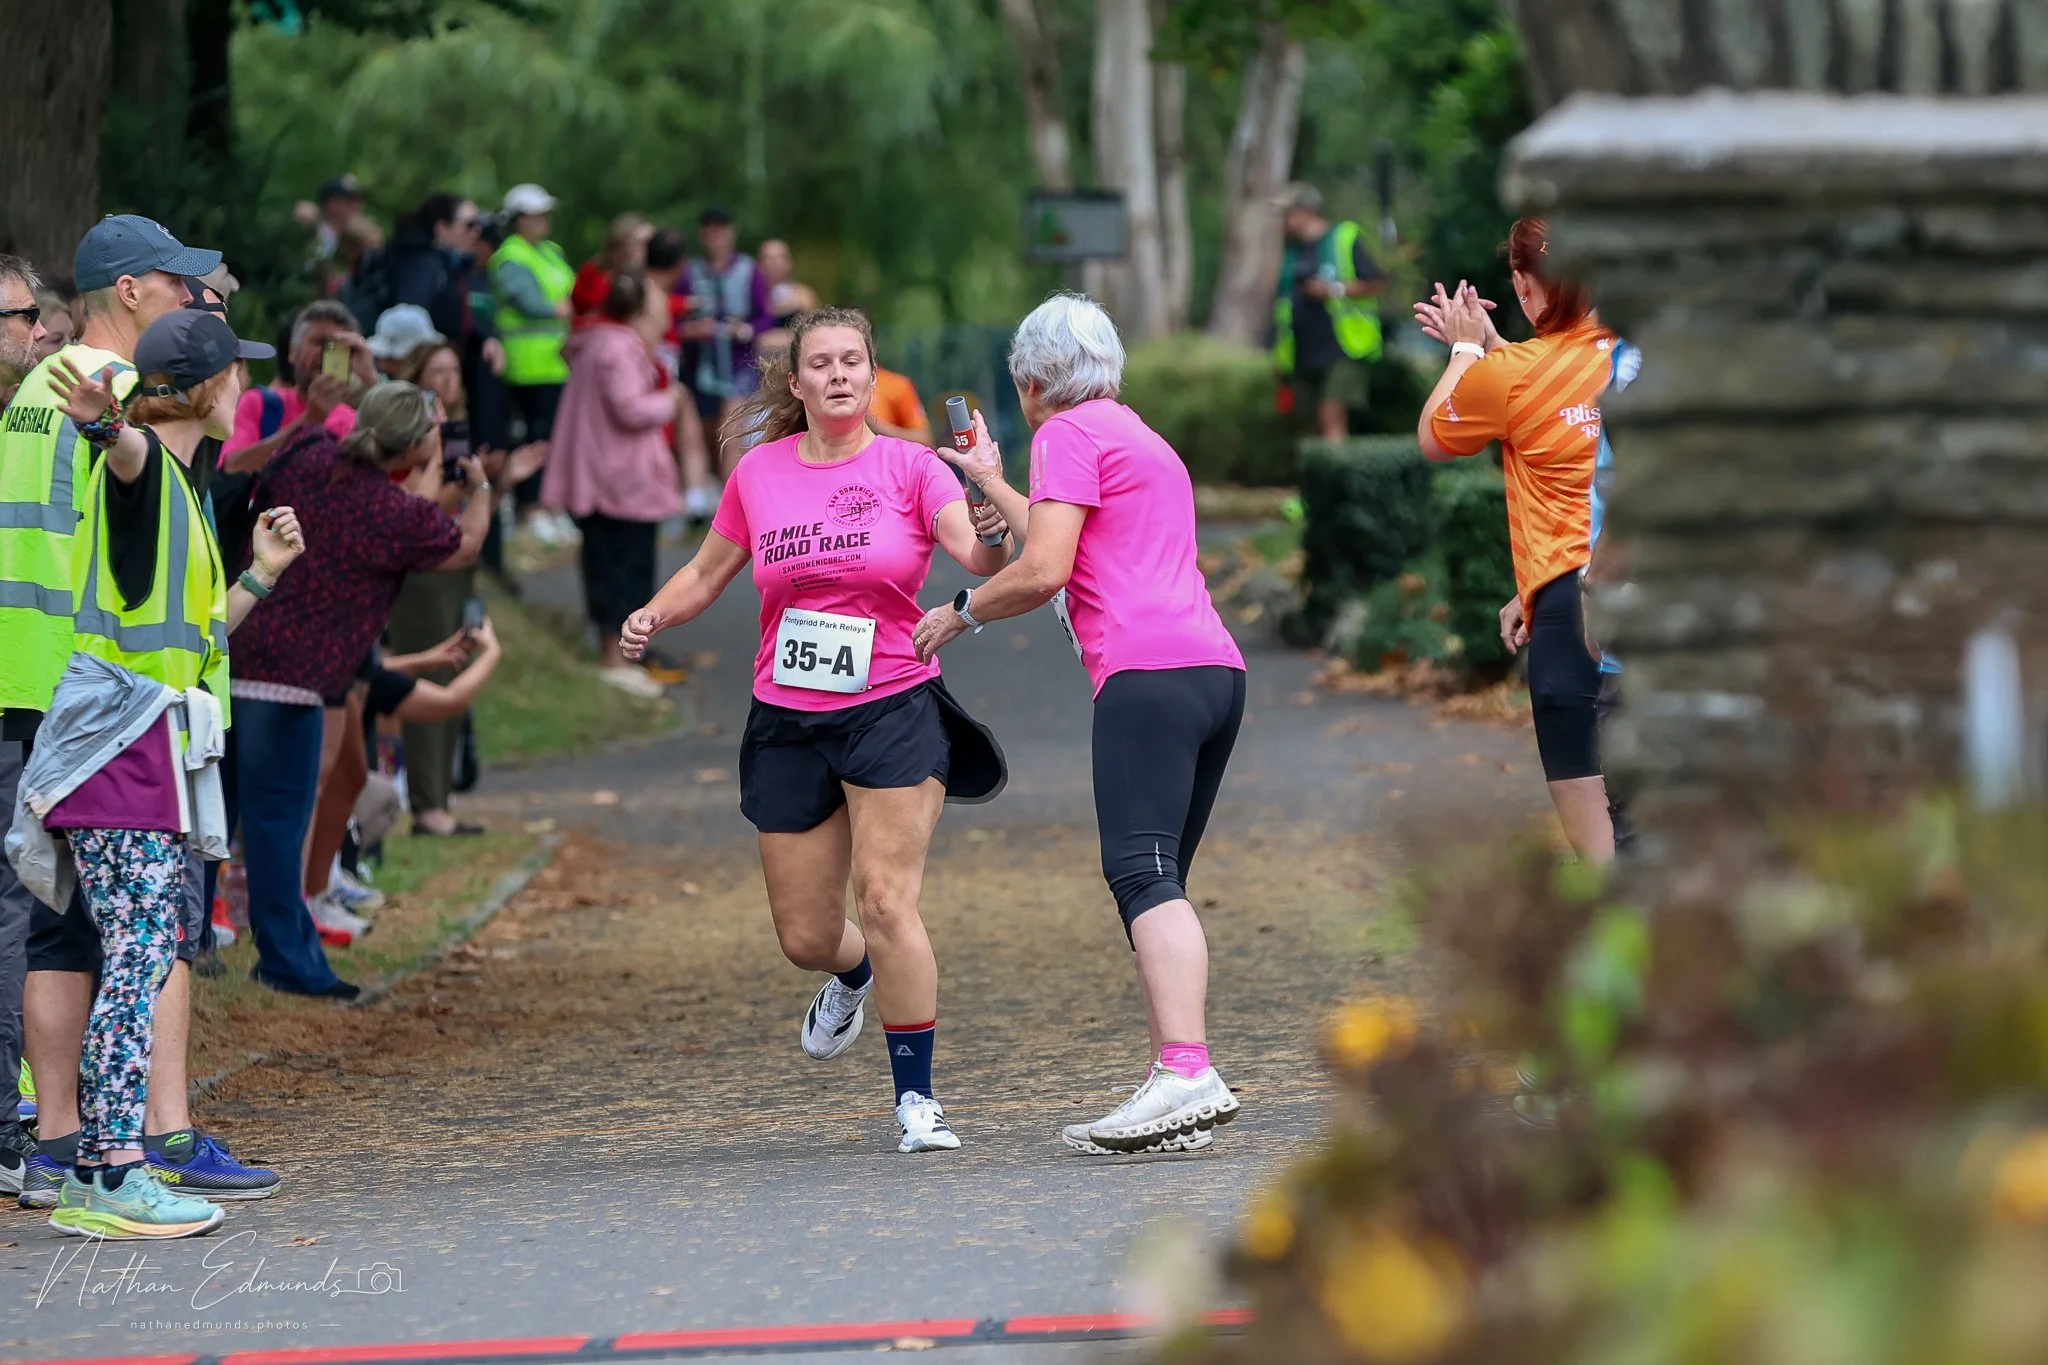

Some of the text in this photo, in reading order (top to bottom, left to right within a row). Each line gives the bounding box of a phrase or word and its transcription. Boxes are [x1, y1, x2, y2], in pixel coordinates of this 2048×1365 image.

[954, 434, 969, 446] 35
[828, 495, 839, 508] SAN
[839, 485, 875, 499] DOMENICO
[758, 522, 824, 552] 20 MILE
[764, 532, 871, 567] ROAD RACE
[782, 553, 861, 575] SANDOMENICORC.COM
[784, 615, 866, 634] Pontypridd Park Relays
[782, 639, 855, 677] 35-A
[153, 1168, 180, 1184] OKA
